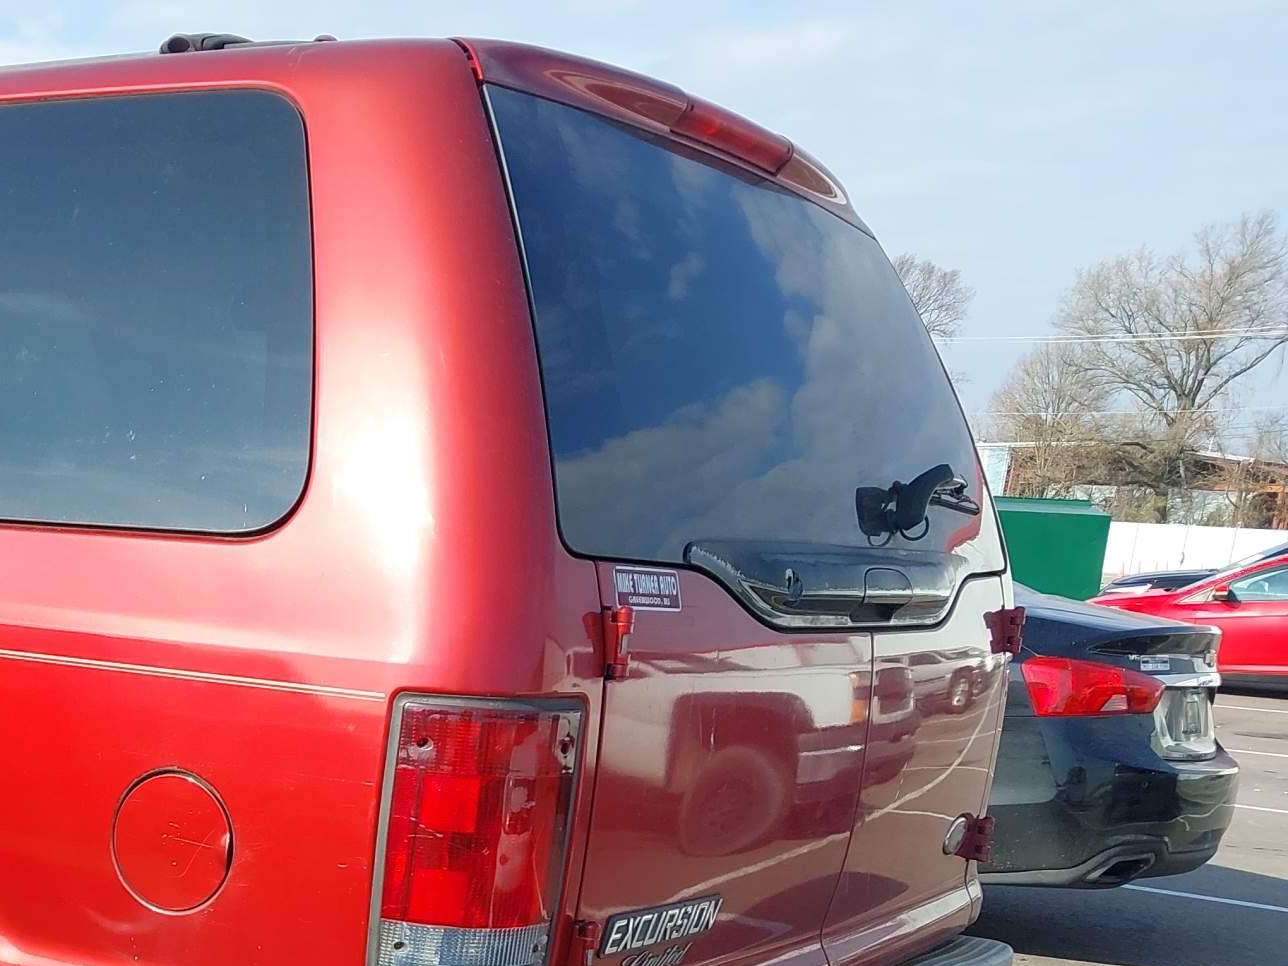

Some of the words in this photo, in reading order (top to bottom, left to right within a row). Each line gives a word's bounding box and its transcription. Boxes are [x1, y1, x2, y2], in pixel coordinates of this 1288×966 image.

[617, 573, 634, 593] MIKE
[633, 573, 659, 595] TURNER
[659, 575, 677, 596] AUTO
[605, 898, 723, 954] EXCURSION
